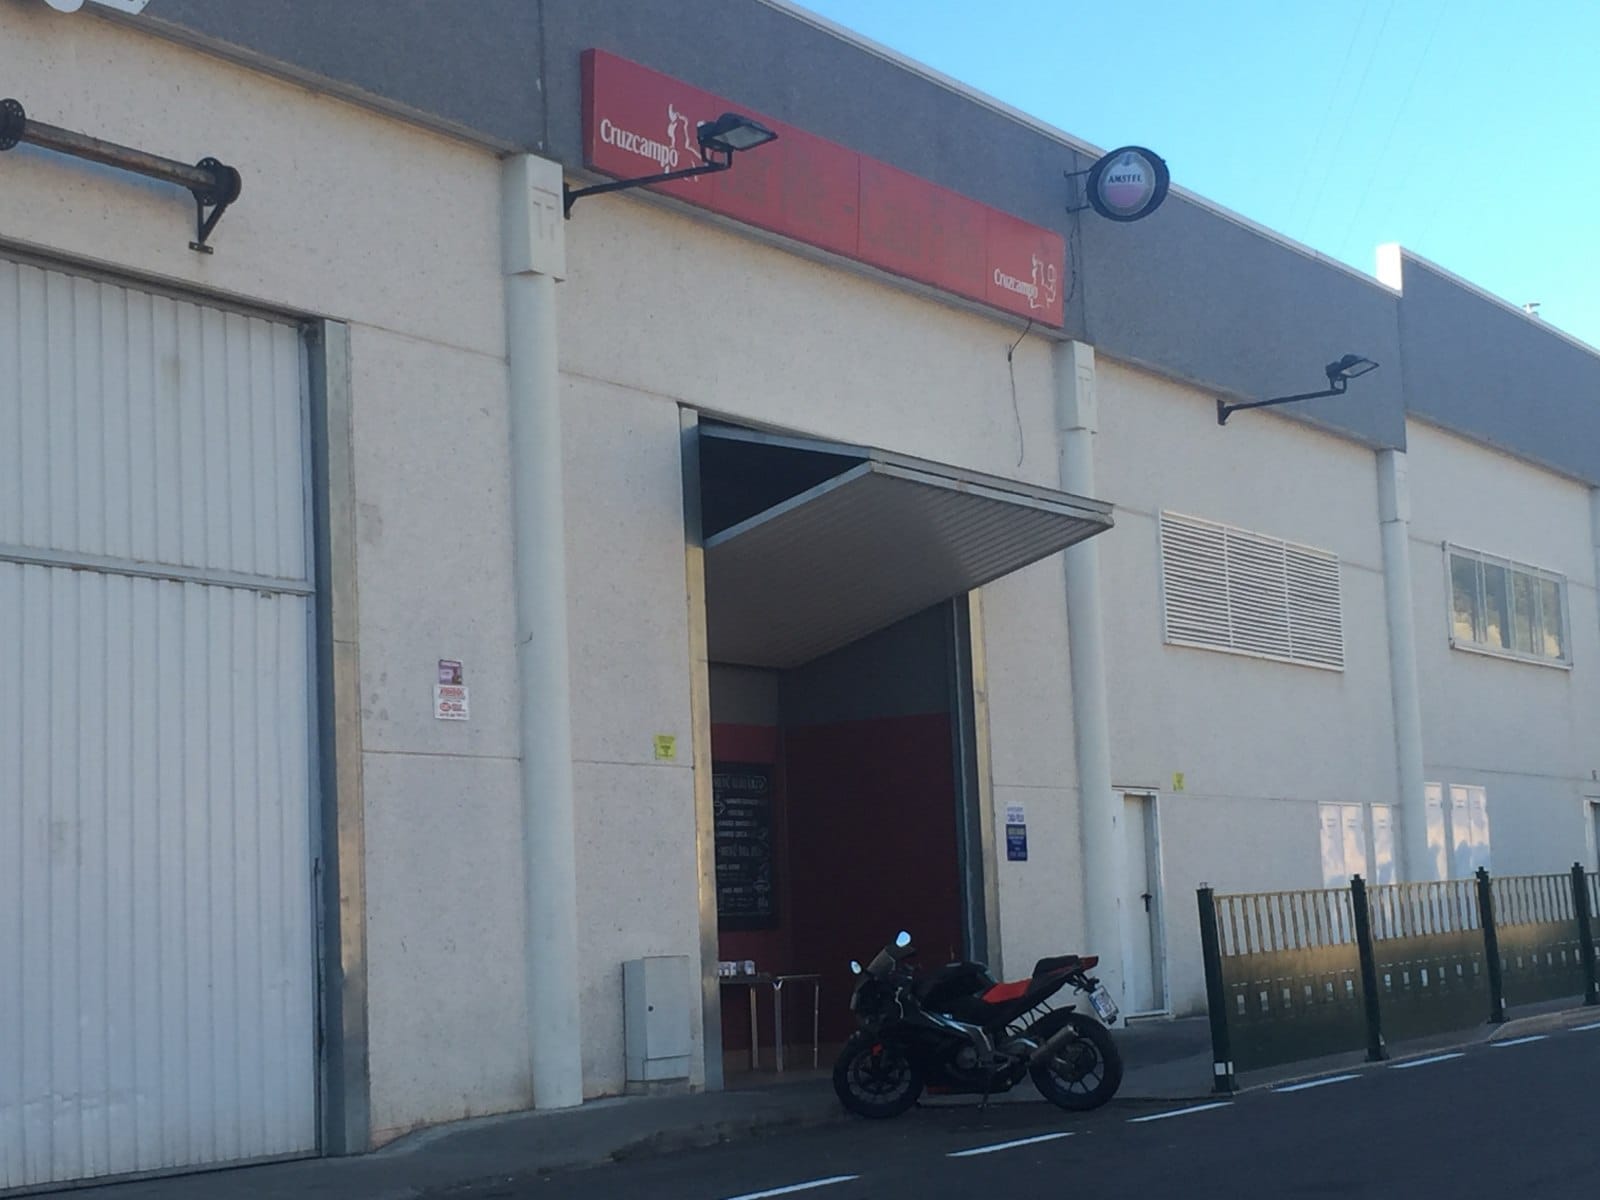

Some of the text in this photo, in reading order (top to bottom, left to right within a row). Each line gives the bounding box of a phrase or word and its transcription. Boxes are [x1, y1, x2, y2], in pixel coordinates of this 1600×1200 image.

[600, 118, 679, 168] Cruzcampo
[1108, 174, 1143, 184] AMSTEL
[993, 267, 1039, 300] Cruzcampo
